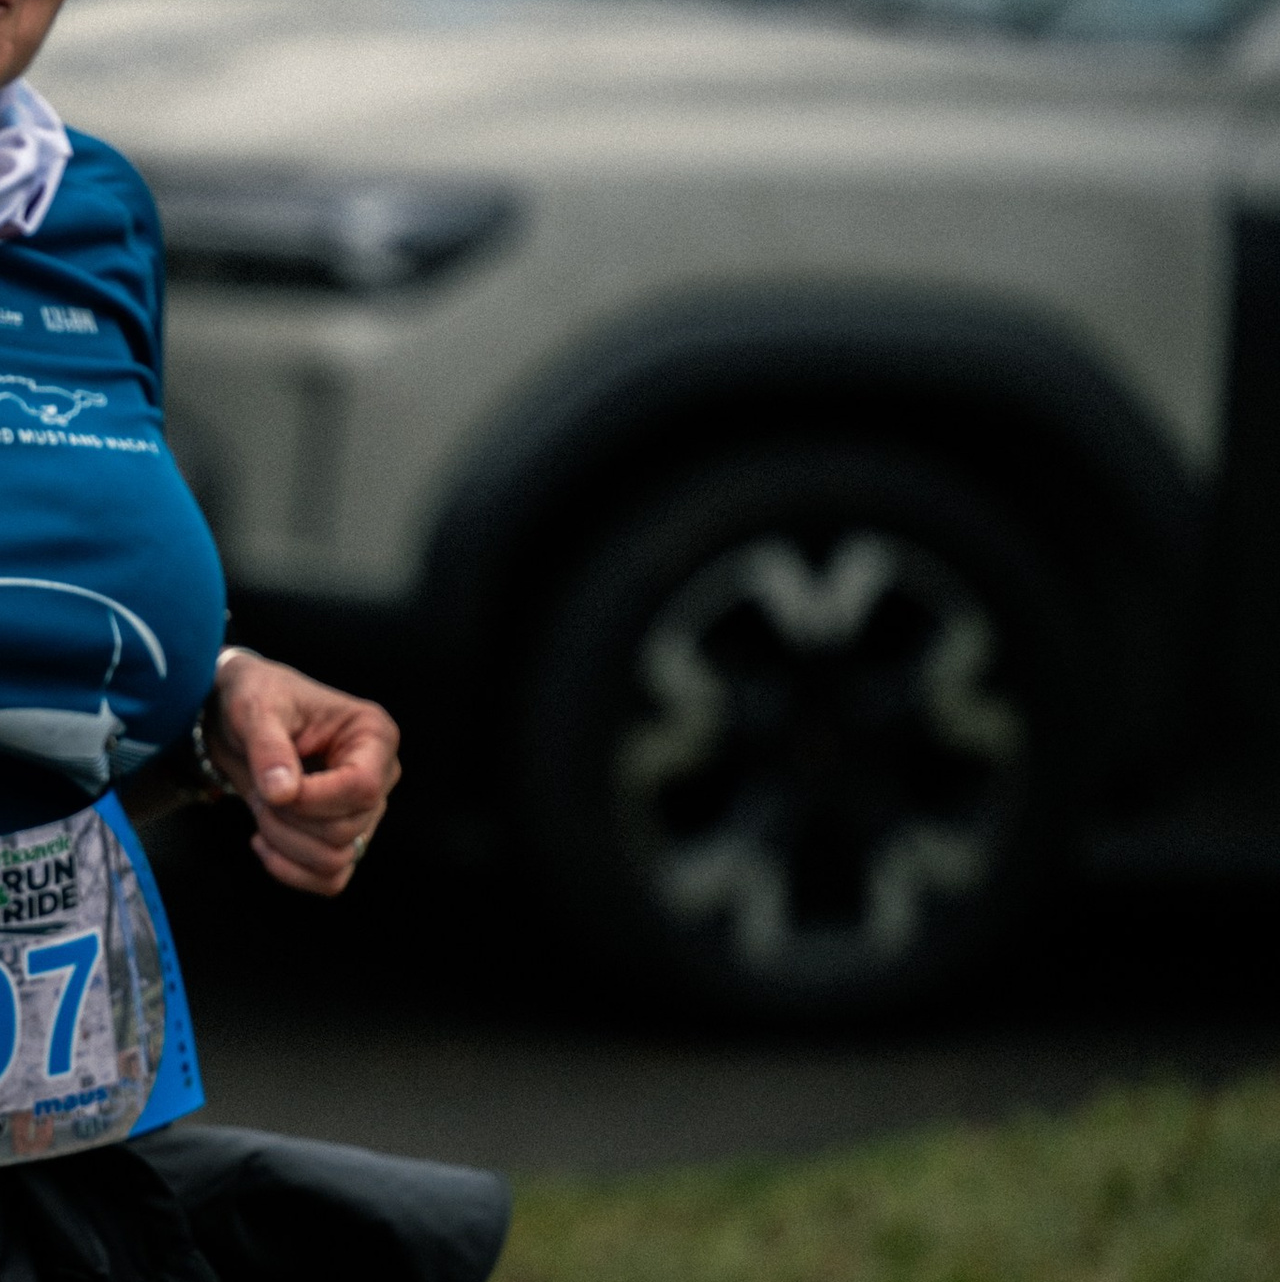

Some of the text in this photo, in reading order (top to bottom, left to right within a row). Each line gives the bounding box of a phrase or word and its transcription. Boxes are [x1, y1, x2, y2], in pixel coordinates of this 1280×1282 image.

[18, 428, 103, 449] MUSTANG
[2, 852, 76, 893] RUN
[3, 882, 78, 924] RIDE
[35, 1085, 108, 1116] maus
